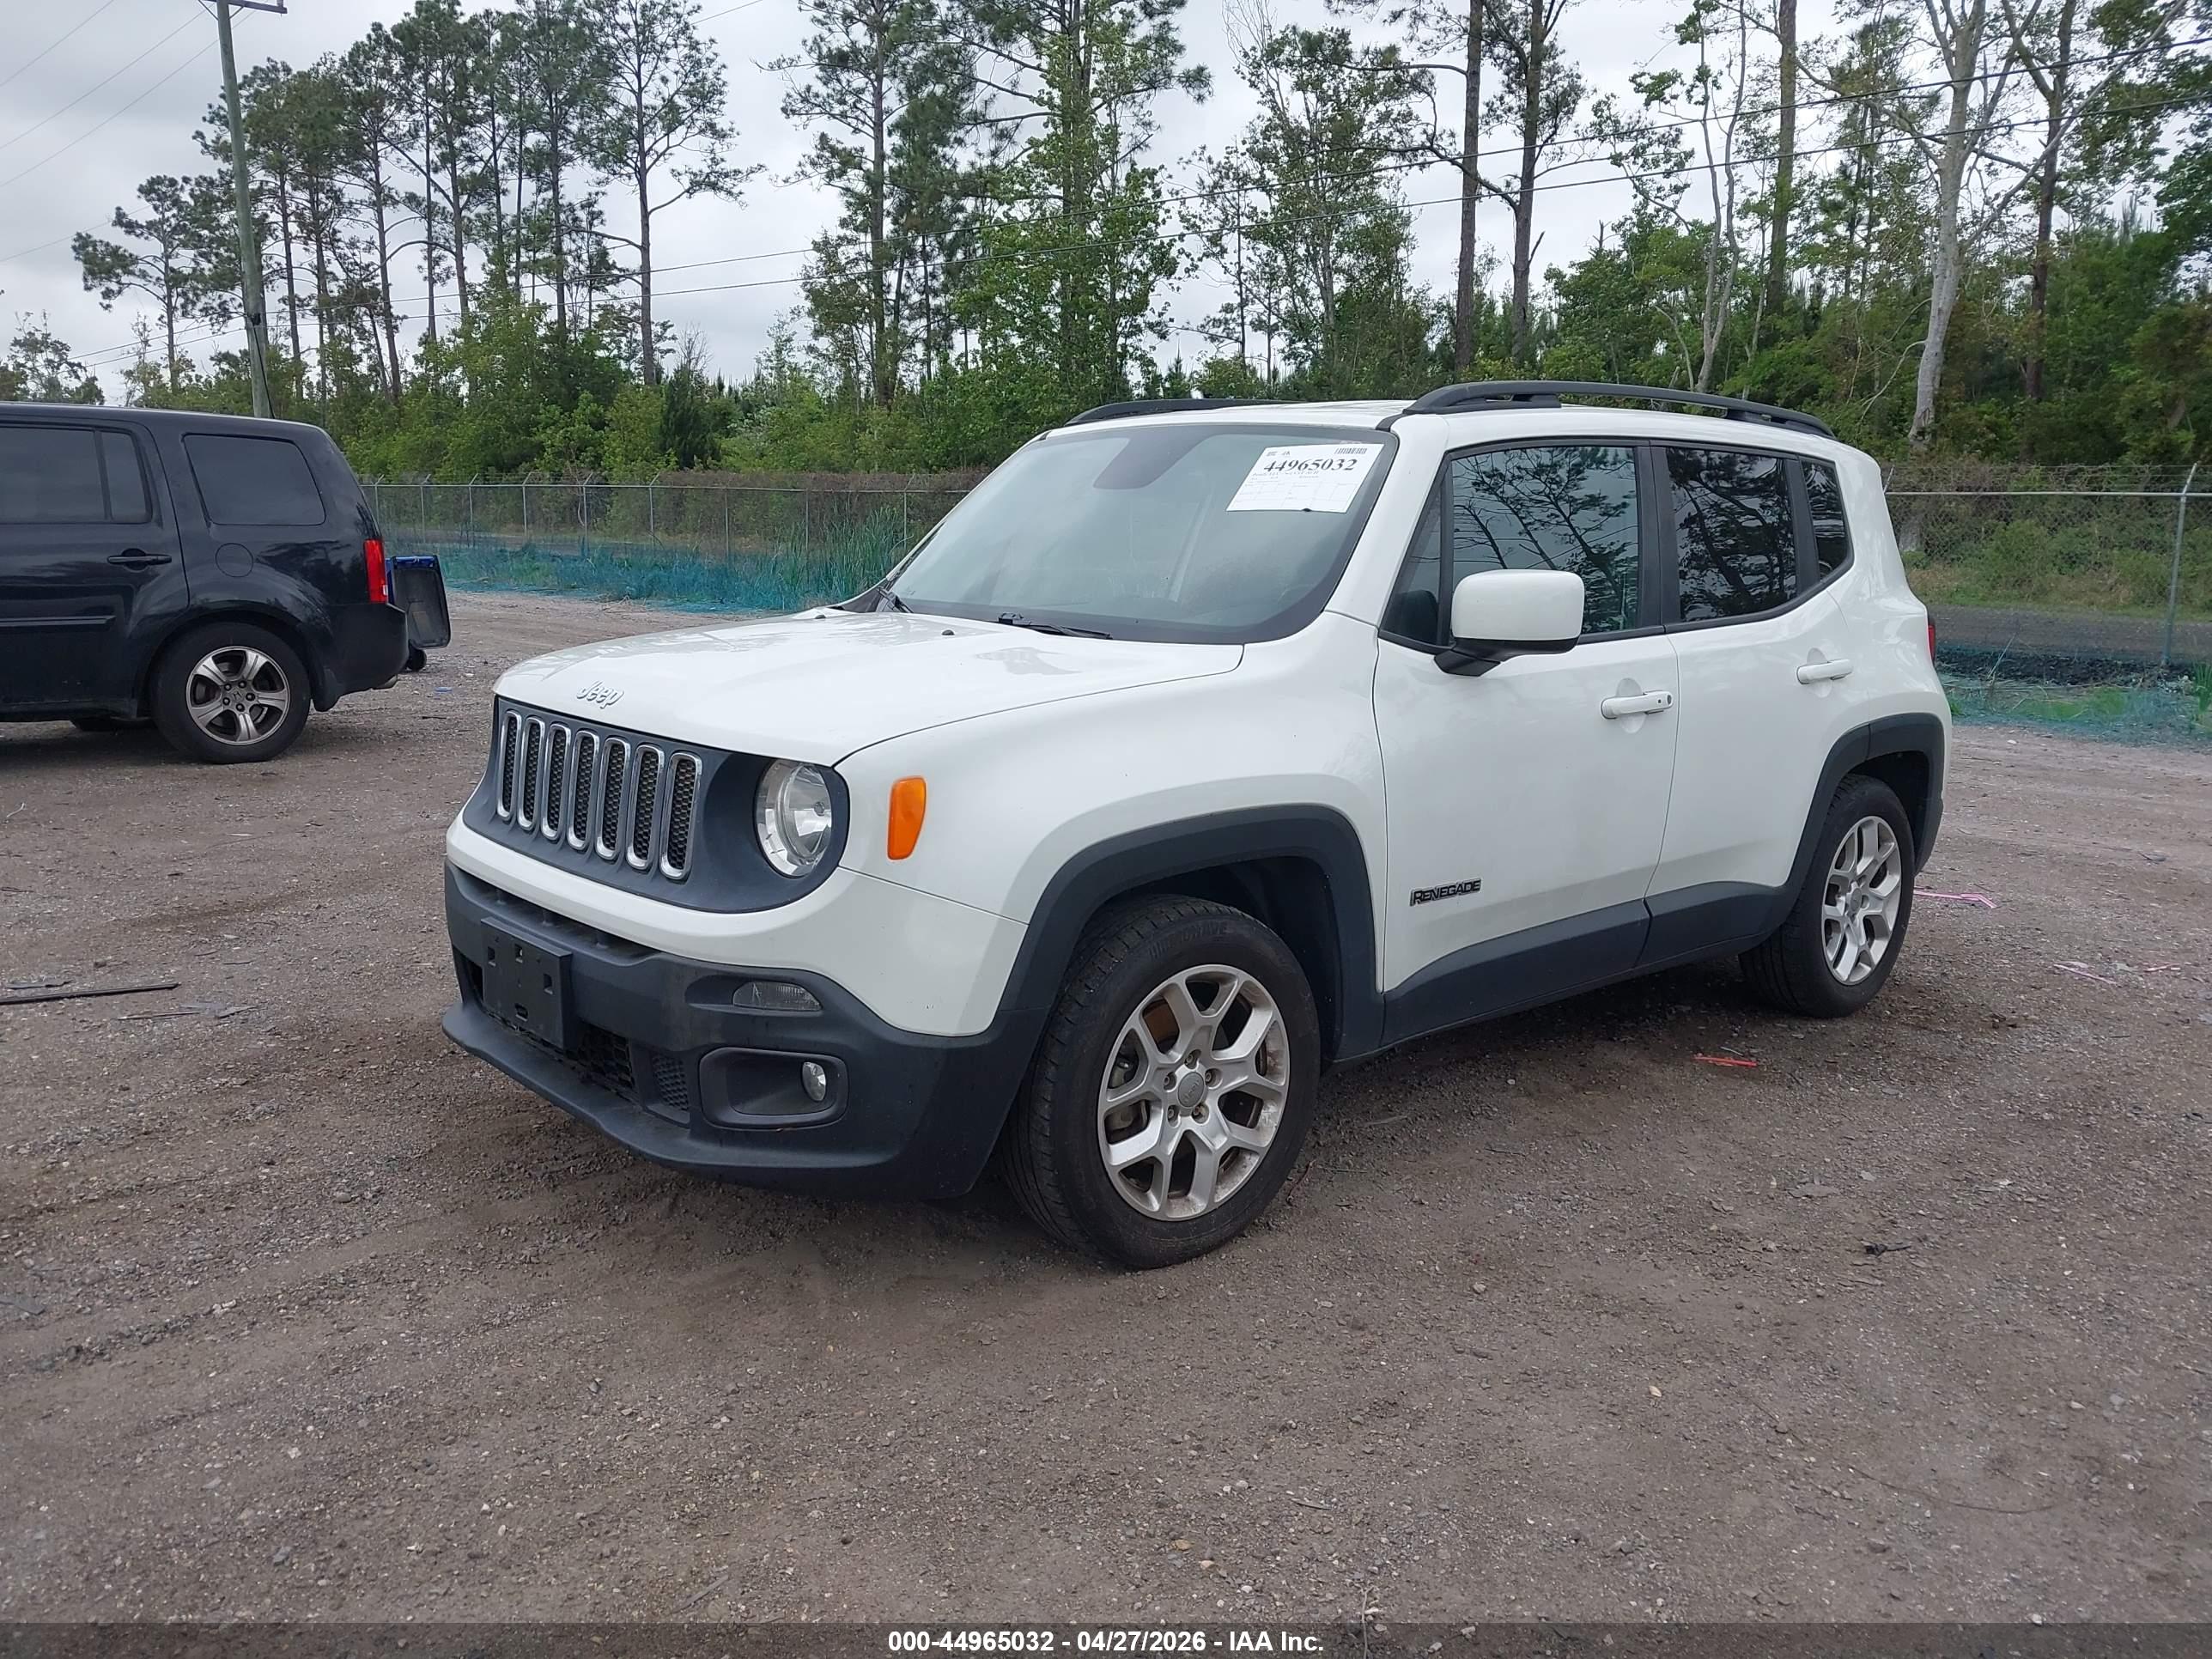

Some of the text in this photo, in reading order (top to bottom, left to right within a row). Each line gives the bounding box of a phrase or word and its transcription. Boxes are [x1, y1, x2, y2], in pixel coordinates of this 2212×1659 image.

[1263, 458, 1358, 472] 44965032
[576, 680, 624, 709] Jeep
[1409, 878, 1481, 907] RENEGADE
